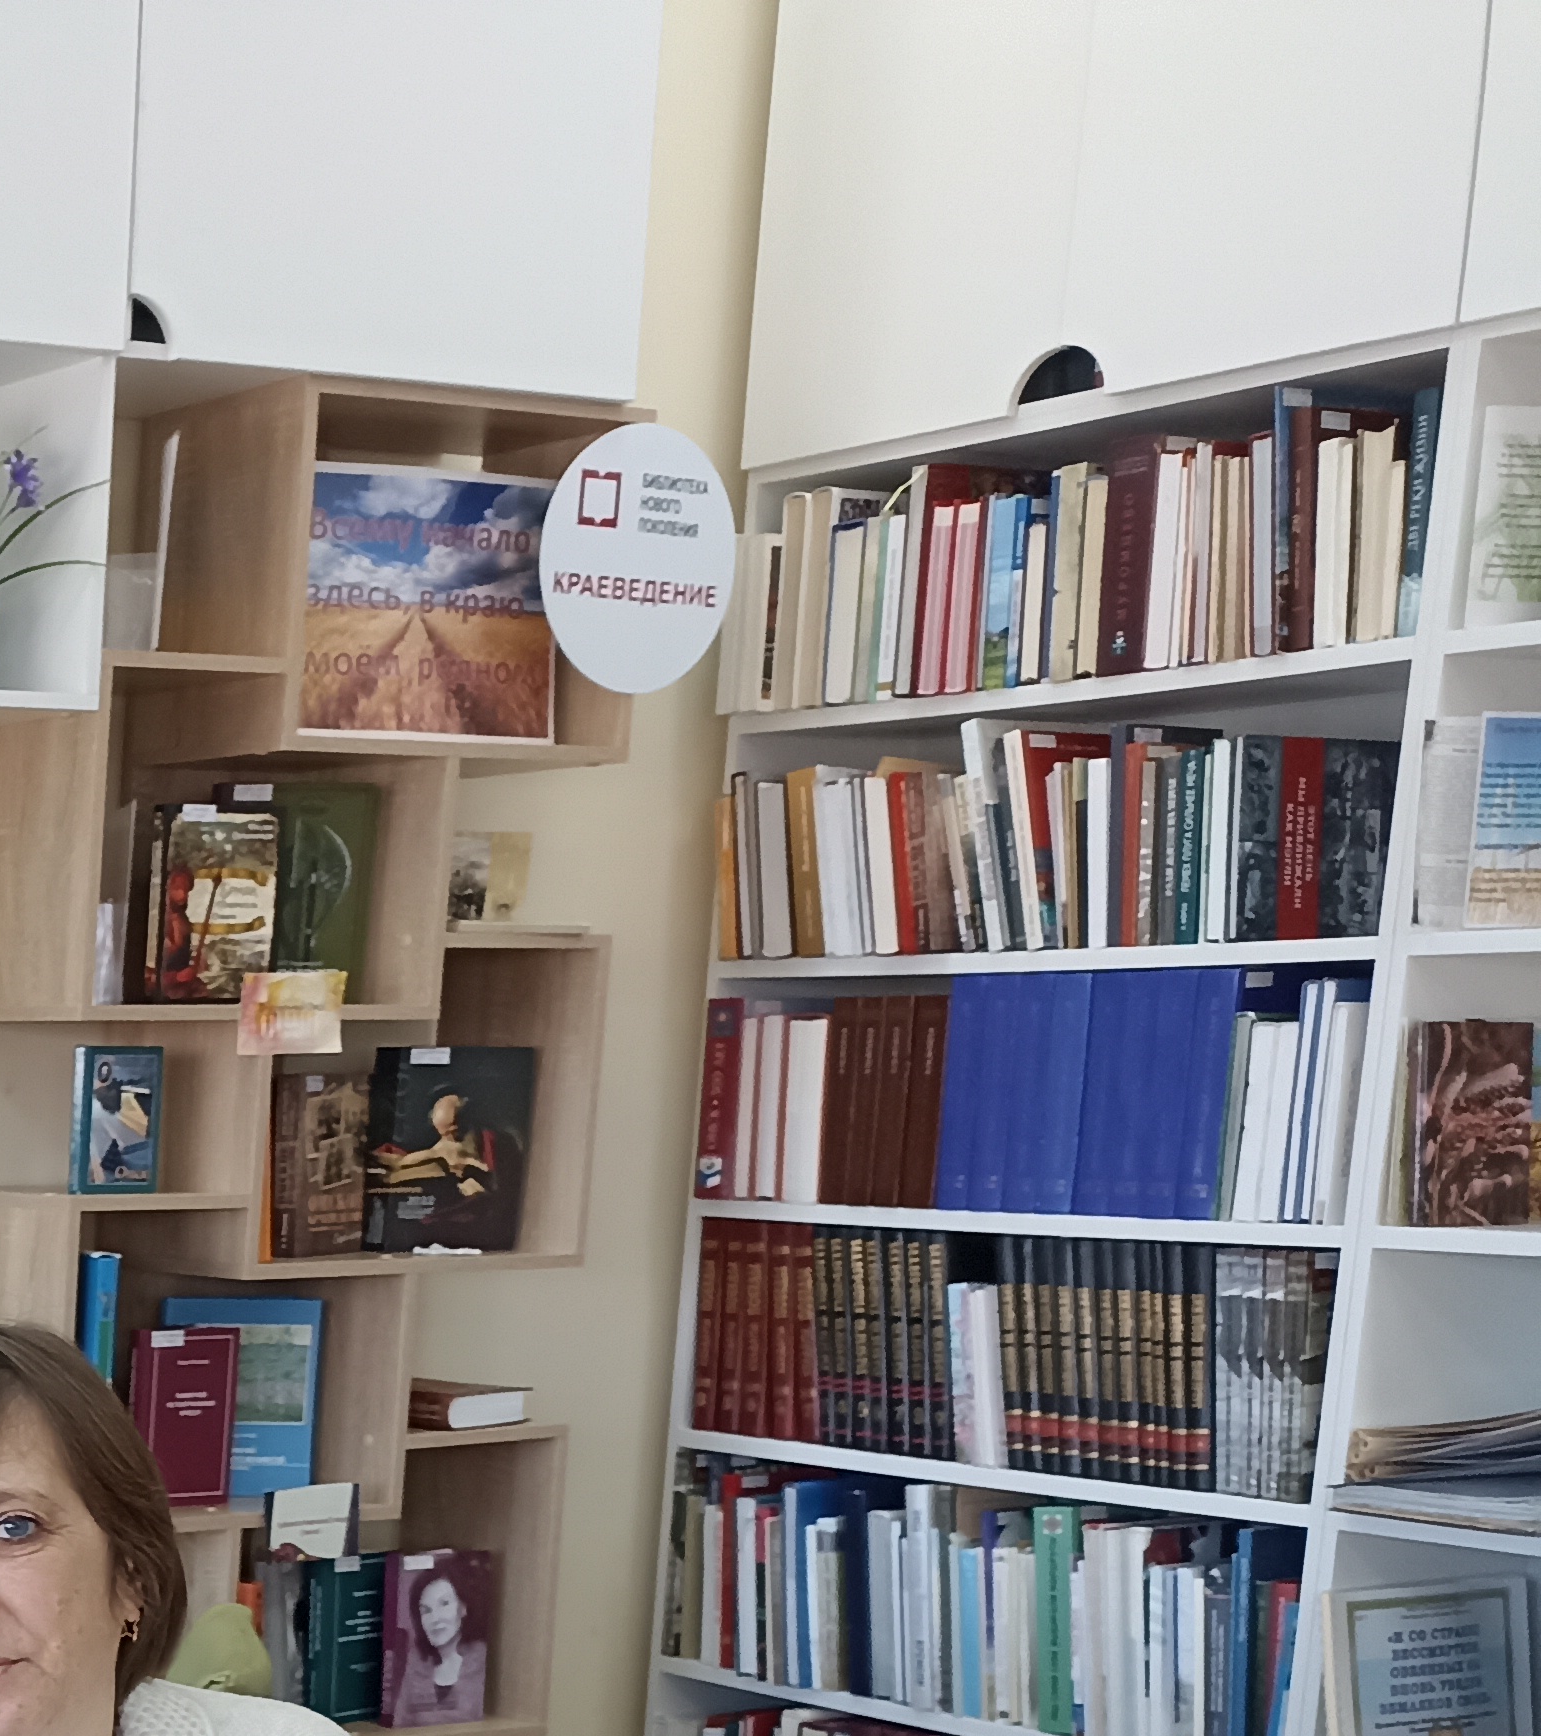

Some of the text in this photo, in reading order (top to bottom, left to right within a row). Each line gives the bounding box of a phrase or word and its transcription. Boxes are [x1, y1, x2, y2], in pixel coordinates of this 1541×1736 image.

[309, 507, 531, 555] Всему начало
[308, 582, 525, 624] здесь, в краю
[553, 570, 718, 609] КРАЕВЕДЕНИЕ
